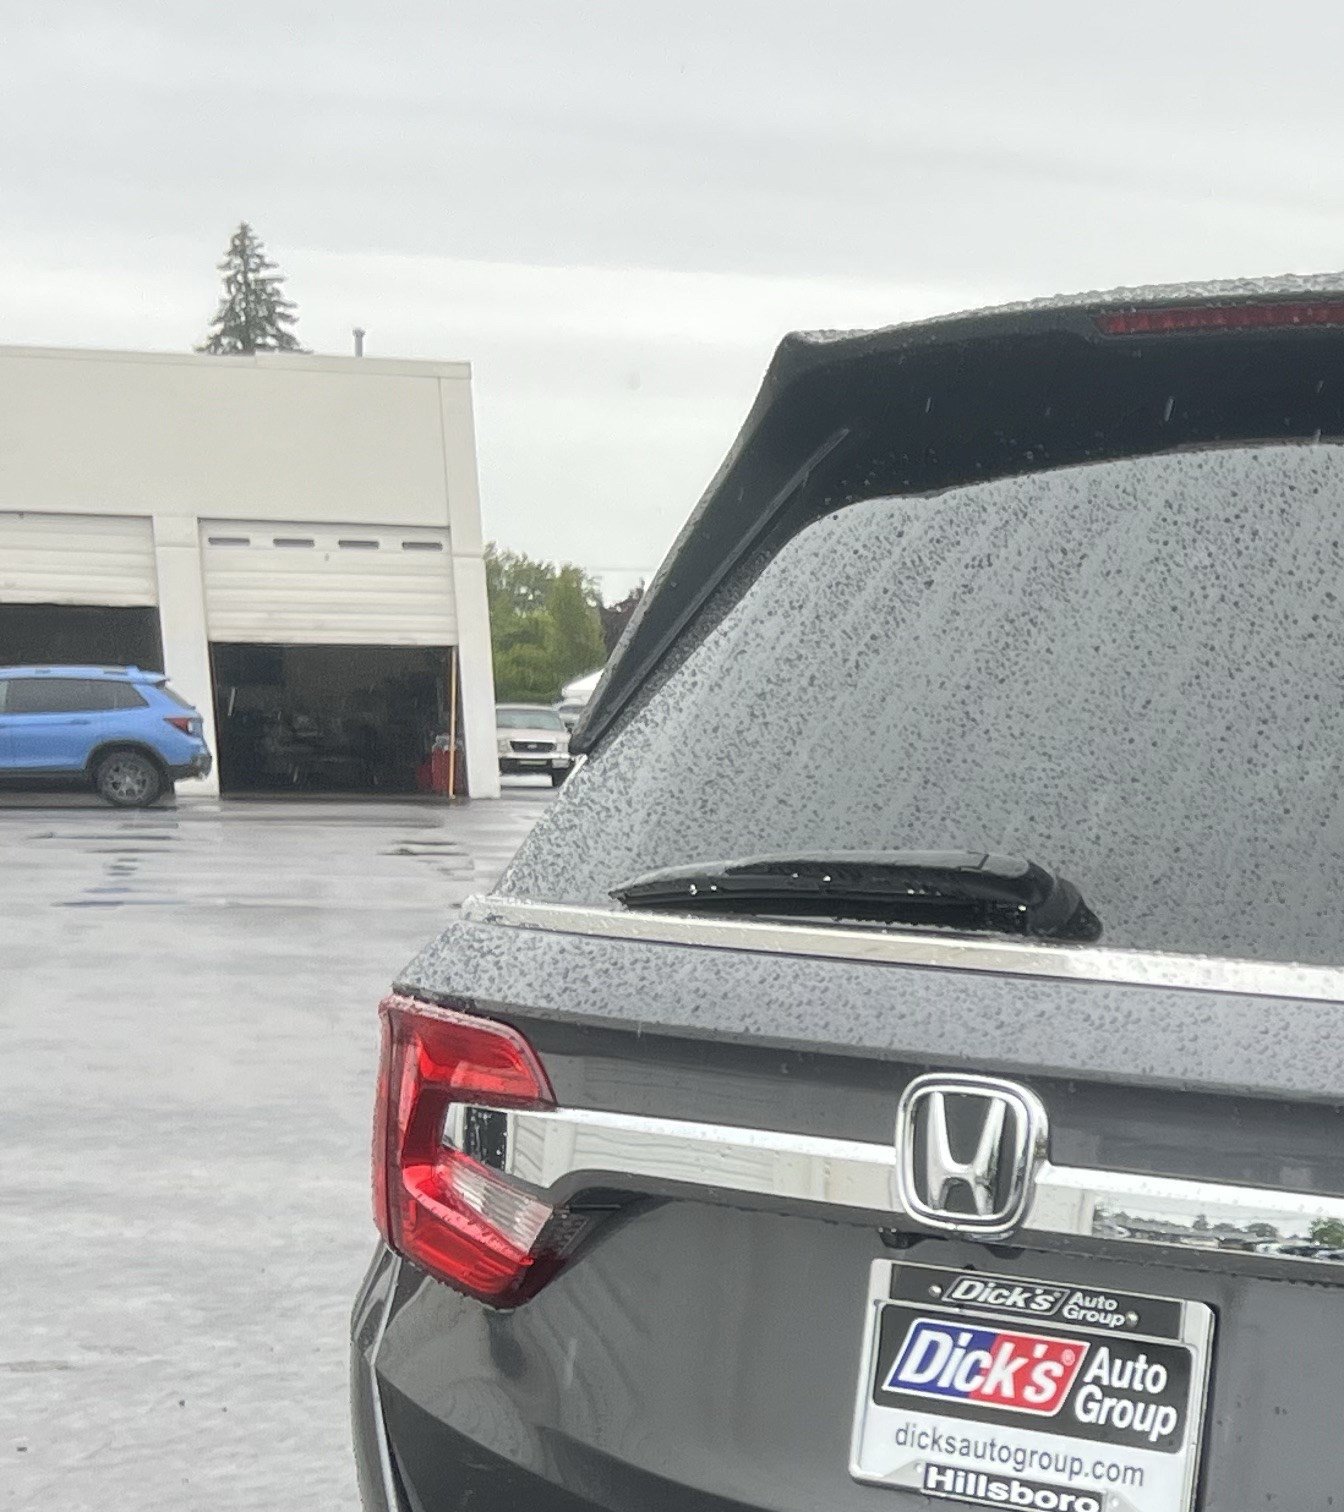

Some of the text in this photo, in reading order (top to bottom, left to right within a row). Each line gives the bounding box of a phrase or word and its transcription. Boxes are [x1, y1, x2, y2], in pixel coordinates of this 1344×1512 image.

[951, 1279, 1056, 1311] Dick's
[1062, 1304, 1126, 1327] Group
[1068, 1291, 1119, 1311] Auto
[898, 1329, 1065, 1404] Dick's
[1083, 1346, 1168, 1394] Auto
[1074, 1384, 1178, 1442] Group
[895, 1422, 1145, 1487] dicksautogroup.com
